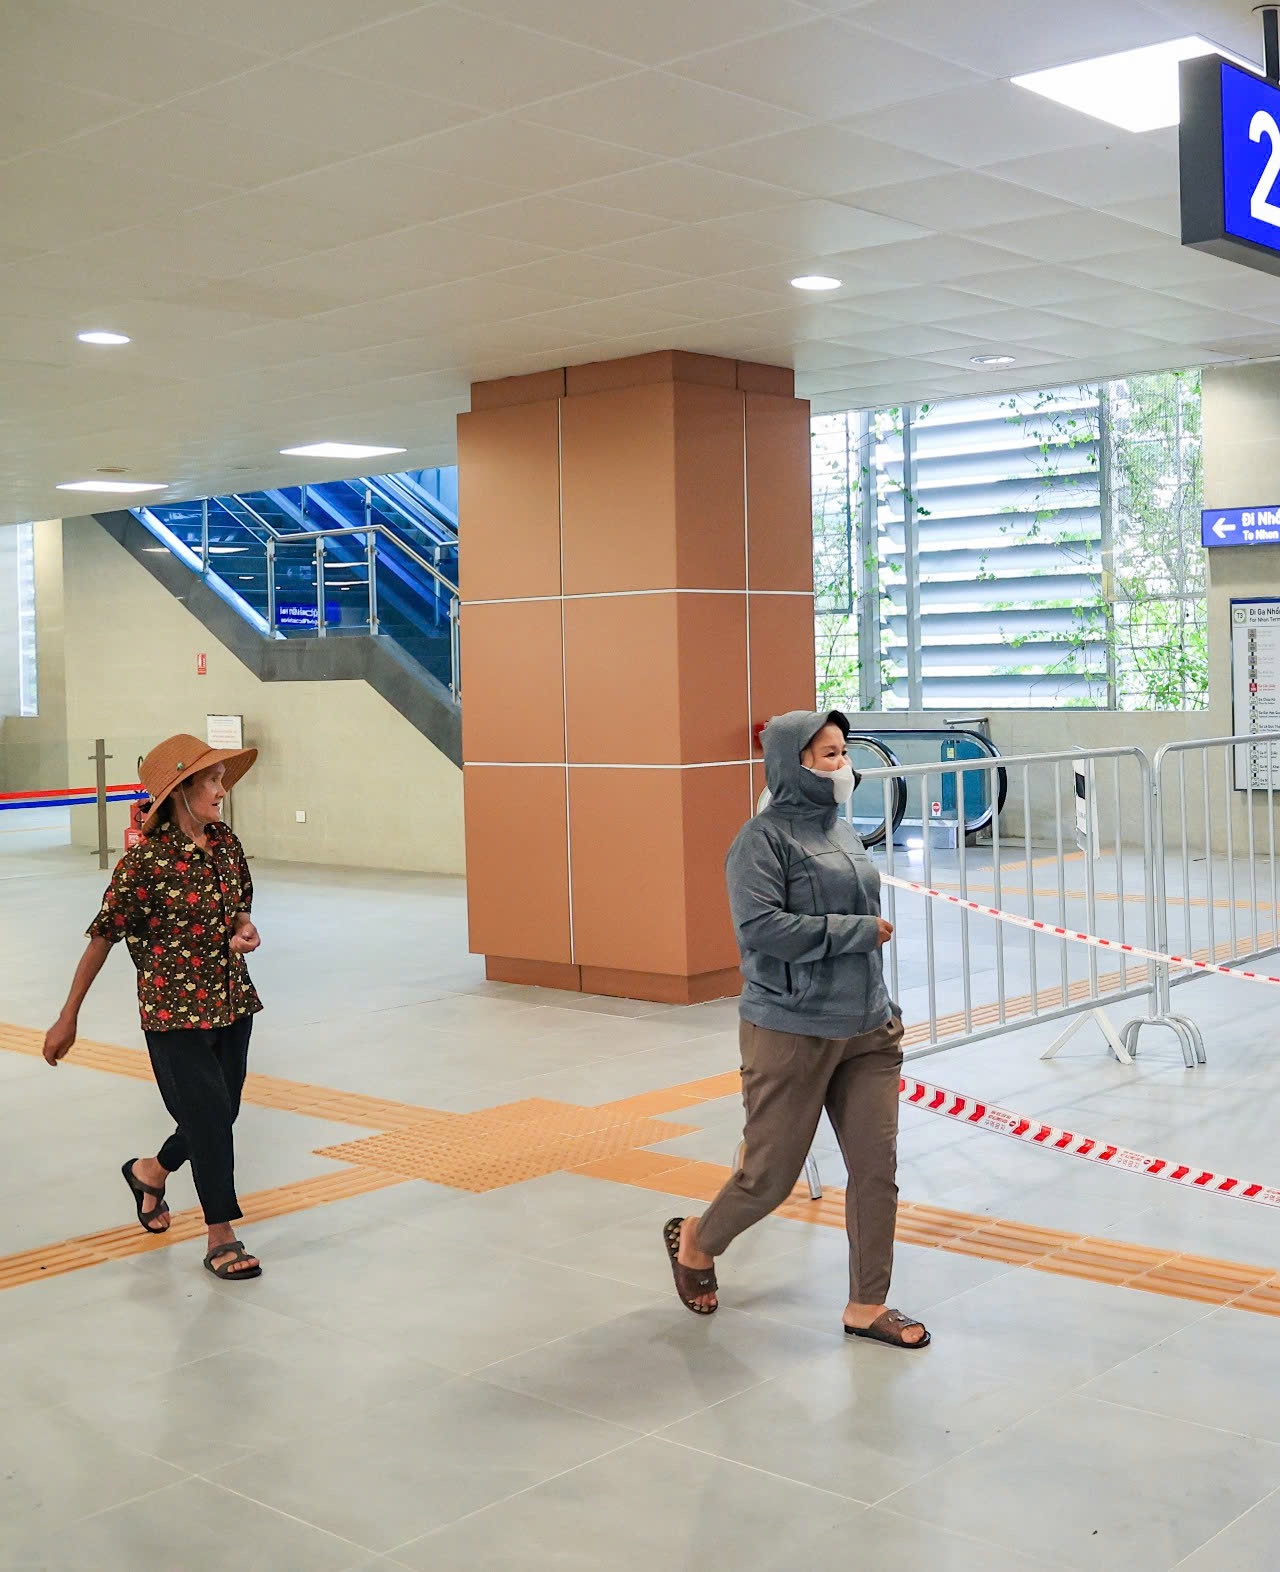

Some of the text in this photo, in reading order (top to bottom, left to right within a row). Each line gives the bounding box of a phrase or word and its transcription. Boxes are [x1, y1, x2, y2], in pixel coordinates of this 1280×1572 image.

[1241, 512, 1255, 527] Đi
[1243, 529, 1279, 540] To Nhon
[1257, 608, 1265, 616] Ga
